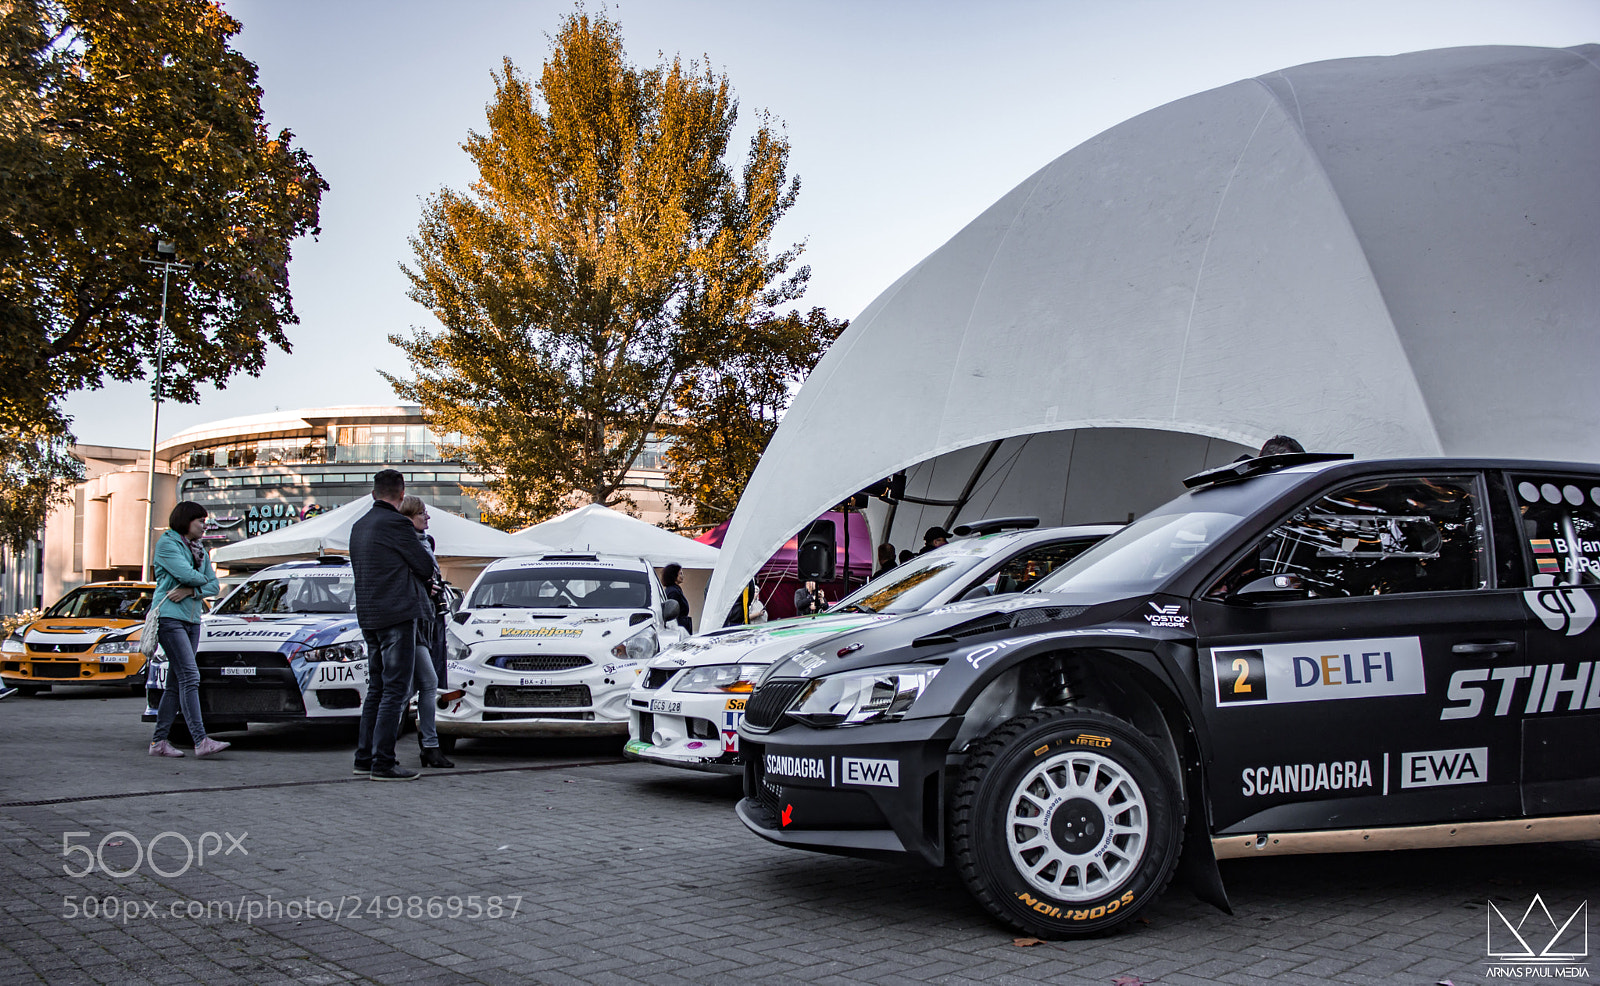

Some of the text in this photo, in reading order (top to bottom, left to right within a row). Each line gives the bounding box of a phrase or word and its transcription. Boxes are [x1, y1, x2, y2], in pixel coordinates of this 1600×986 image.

[248, 504, 296, 518] AQUA
[1143, 614, 1190, 623] VOSTOK
[500, 627, 584, 638] Vorobjovs
[319, 666, 355, 682] JUTA
[1231, 651, 1394, 694] 2 DELFI
[728, 699, 746, 710] Sa
[766, 754, 893, 783] SCANDAGRA EWA
[1242, 753, 1479, 796] SCANDAGRA EWA
